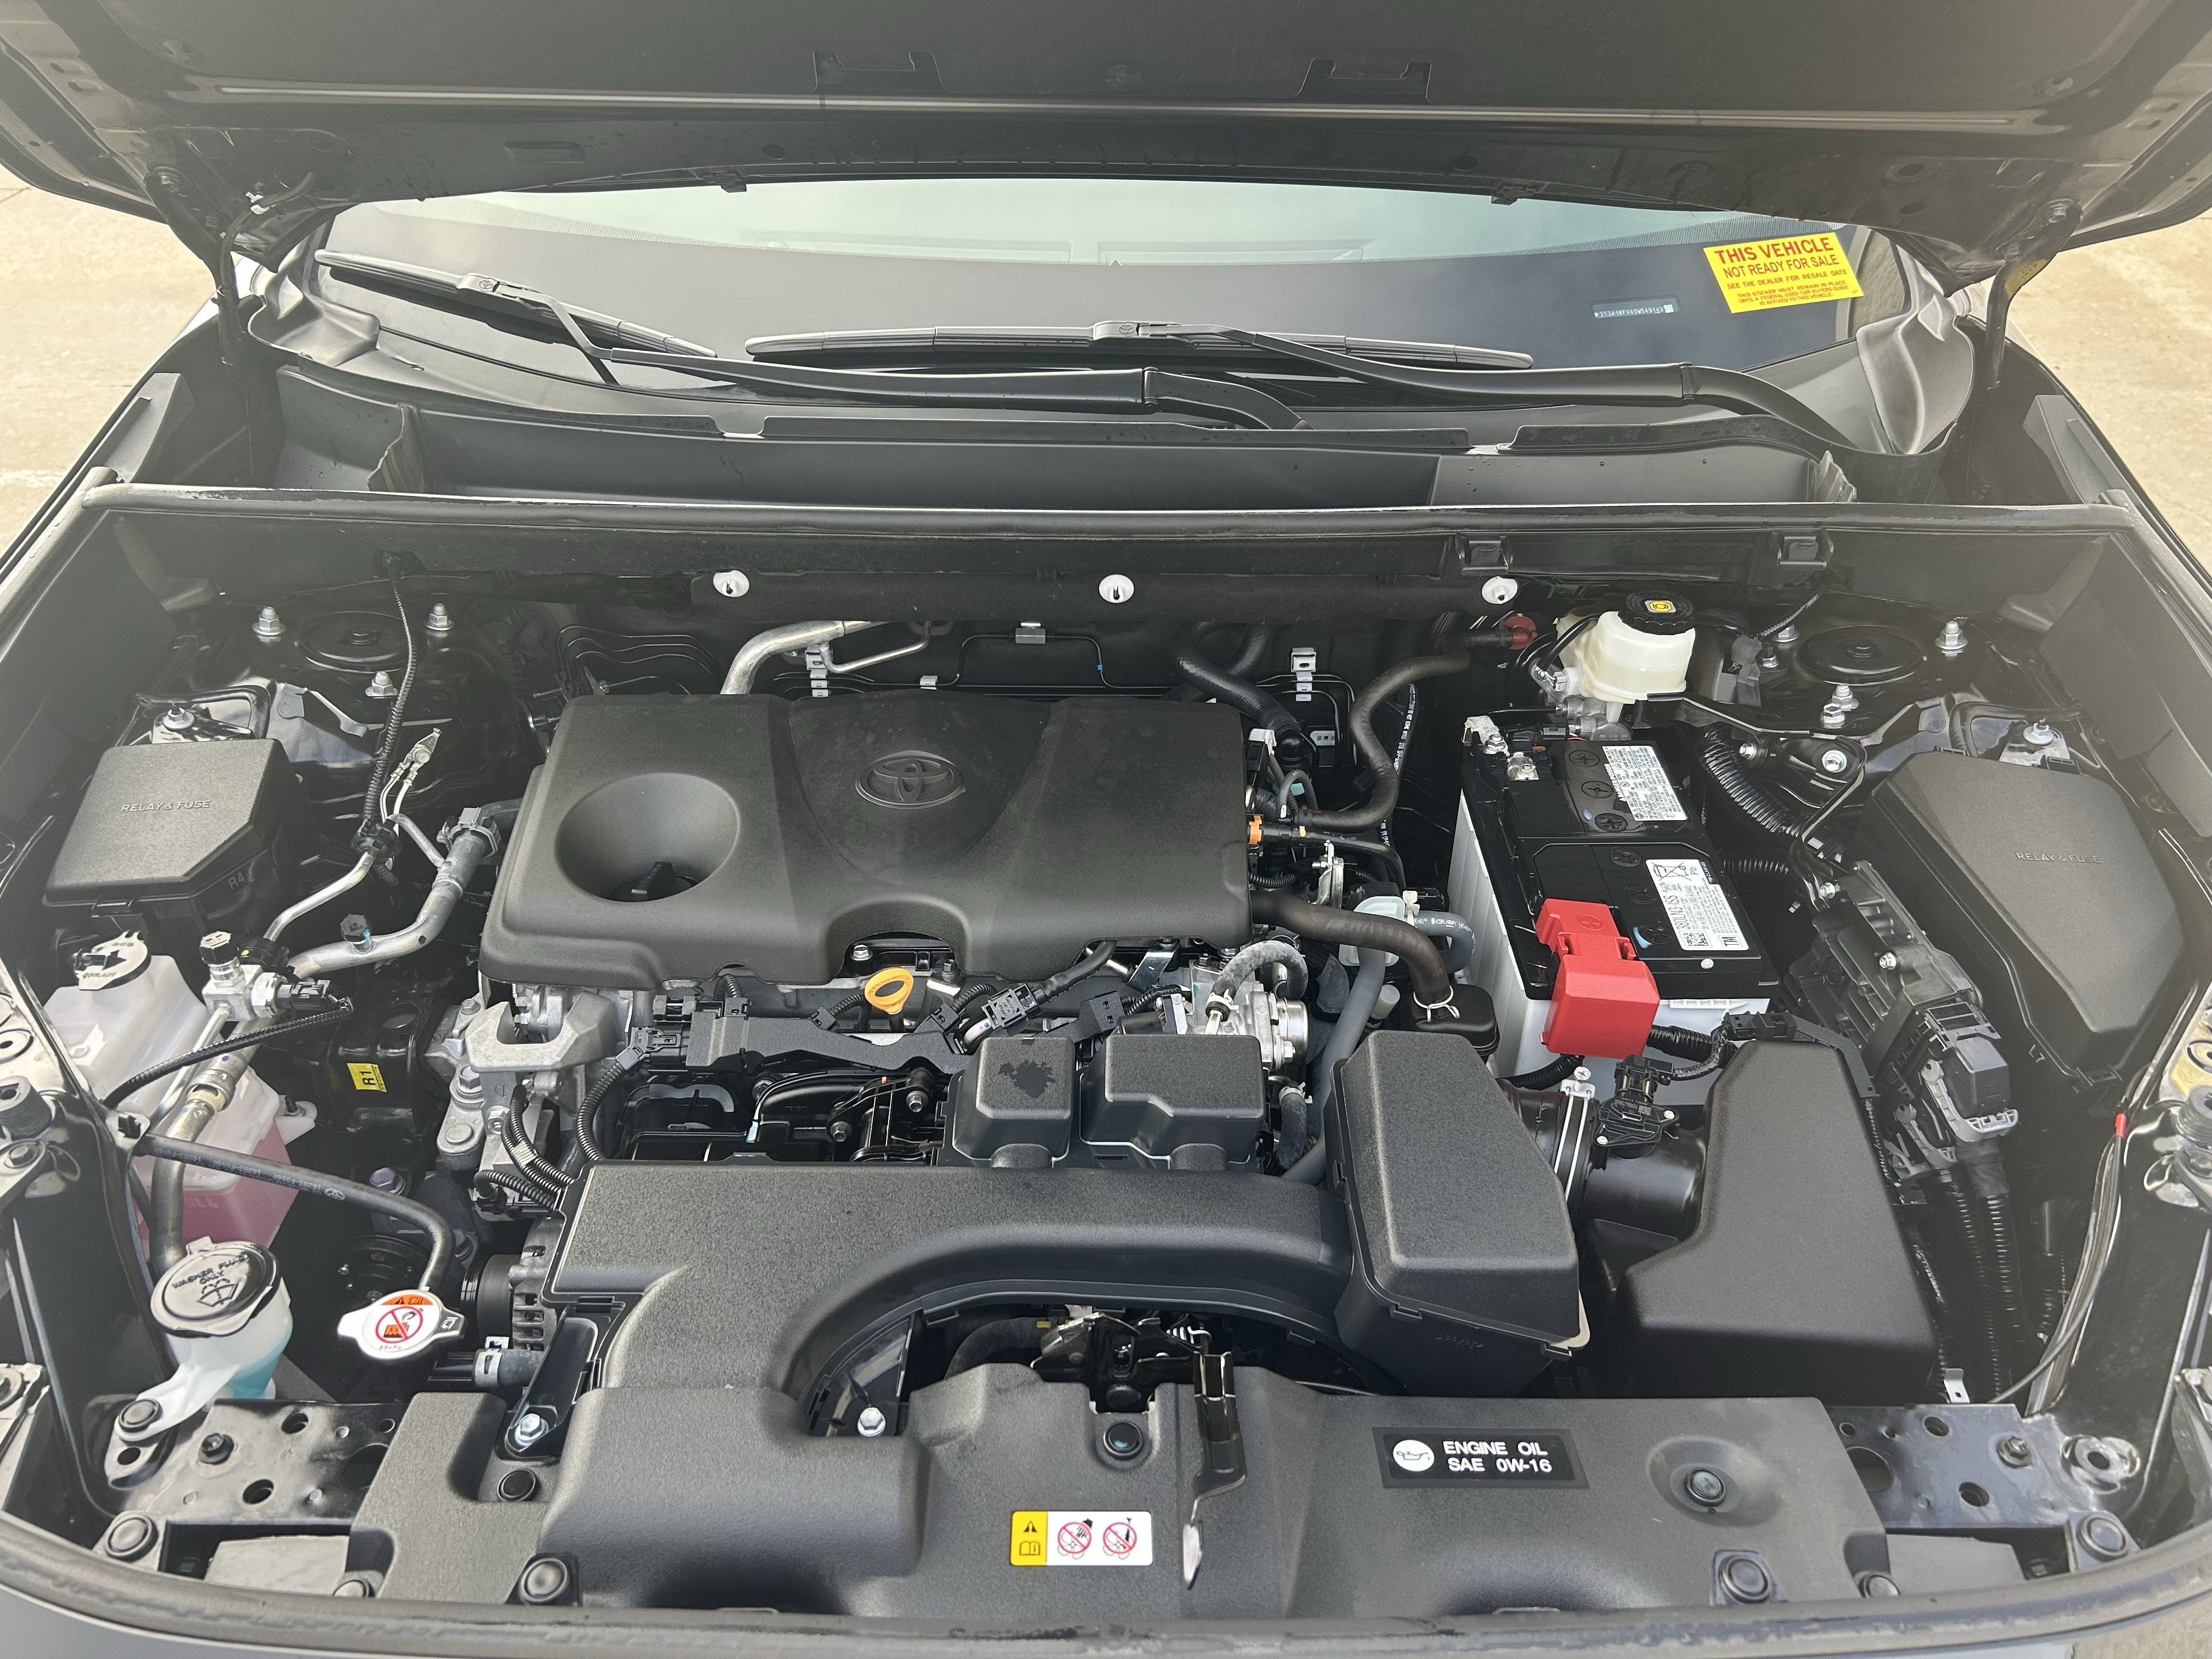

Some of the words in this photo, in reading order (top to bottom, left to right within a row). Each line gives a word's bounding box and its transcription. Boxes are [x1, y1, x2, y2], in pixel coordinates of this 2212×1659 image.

[1714, 247, 1757, 264] THIS
[1758, 238, 1834, 258] VEHICLE
[1723, 266, 1746, 278] NOT
[1747, 261, 1784, 275] READY
[1786, 258, 1810, 270] FOR
[1810, 254, 1839, 267] SALE
[1758, 277, 1783, 285] DEALER
[121, 802, 165, 812] RELAY
[177, 800, 212, 810] FUSE
[2016, 852, 2055, 862] RELAY
[2068, 854, 2102, 864] FUSE
[1690, 867, 1699, 875] Pb
[227, 872, 245, 890] R4
[1663, 894, 1691, 930] 380LN3-ISS
[1721, 936, 1740, 947] TM
[2029, 1044, 2045, 1063] L7
[359, 1071, 376, 1085] R1
[171, 1268, 213, 1288] WASHER
[218, 1250, 249, 1269] FLUID
[199, 1270, 224, 1284] ONLY
[1443, 1441, 1508, 1455] ENGINE
[1517, 1442, 1548, 1456] OIL
[1447, 1458, 1485, 1472] SAE
[1496, 1458, 1553, 1472] 0W-16
